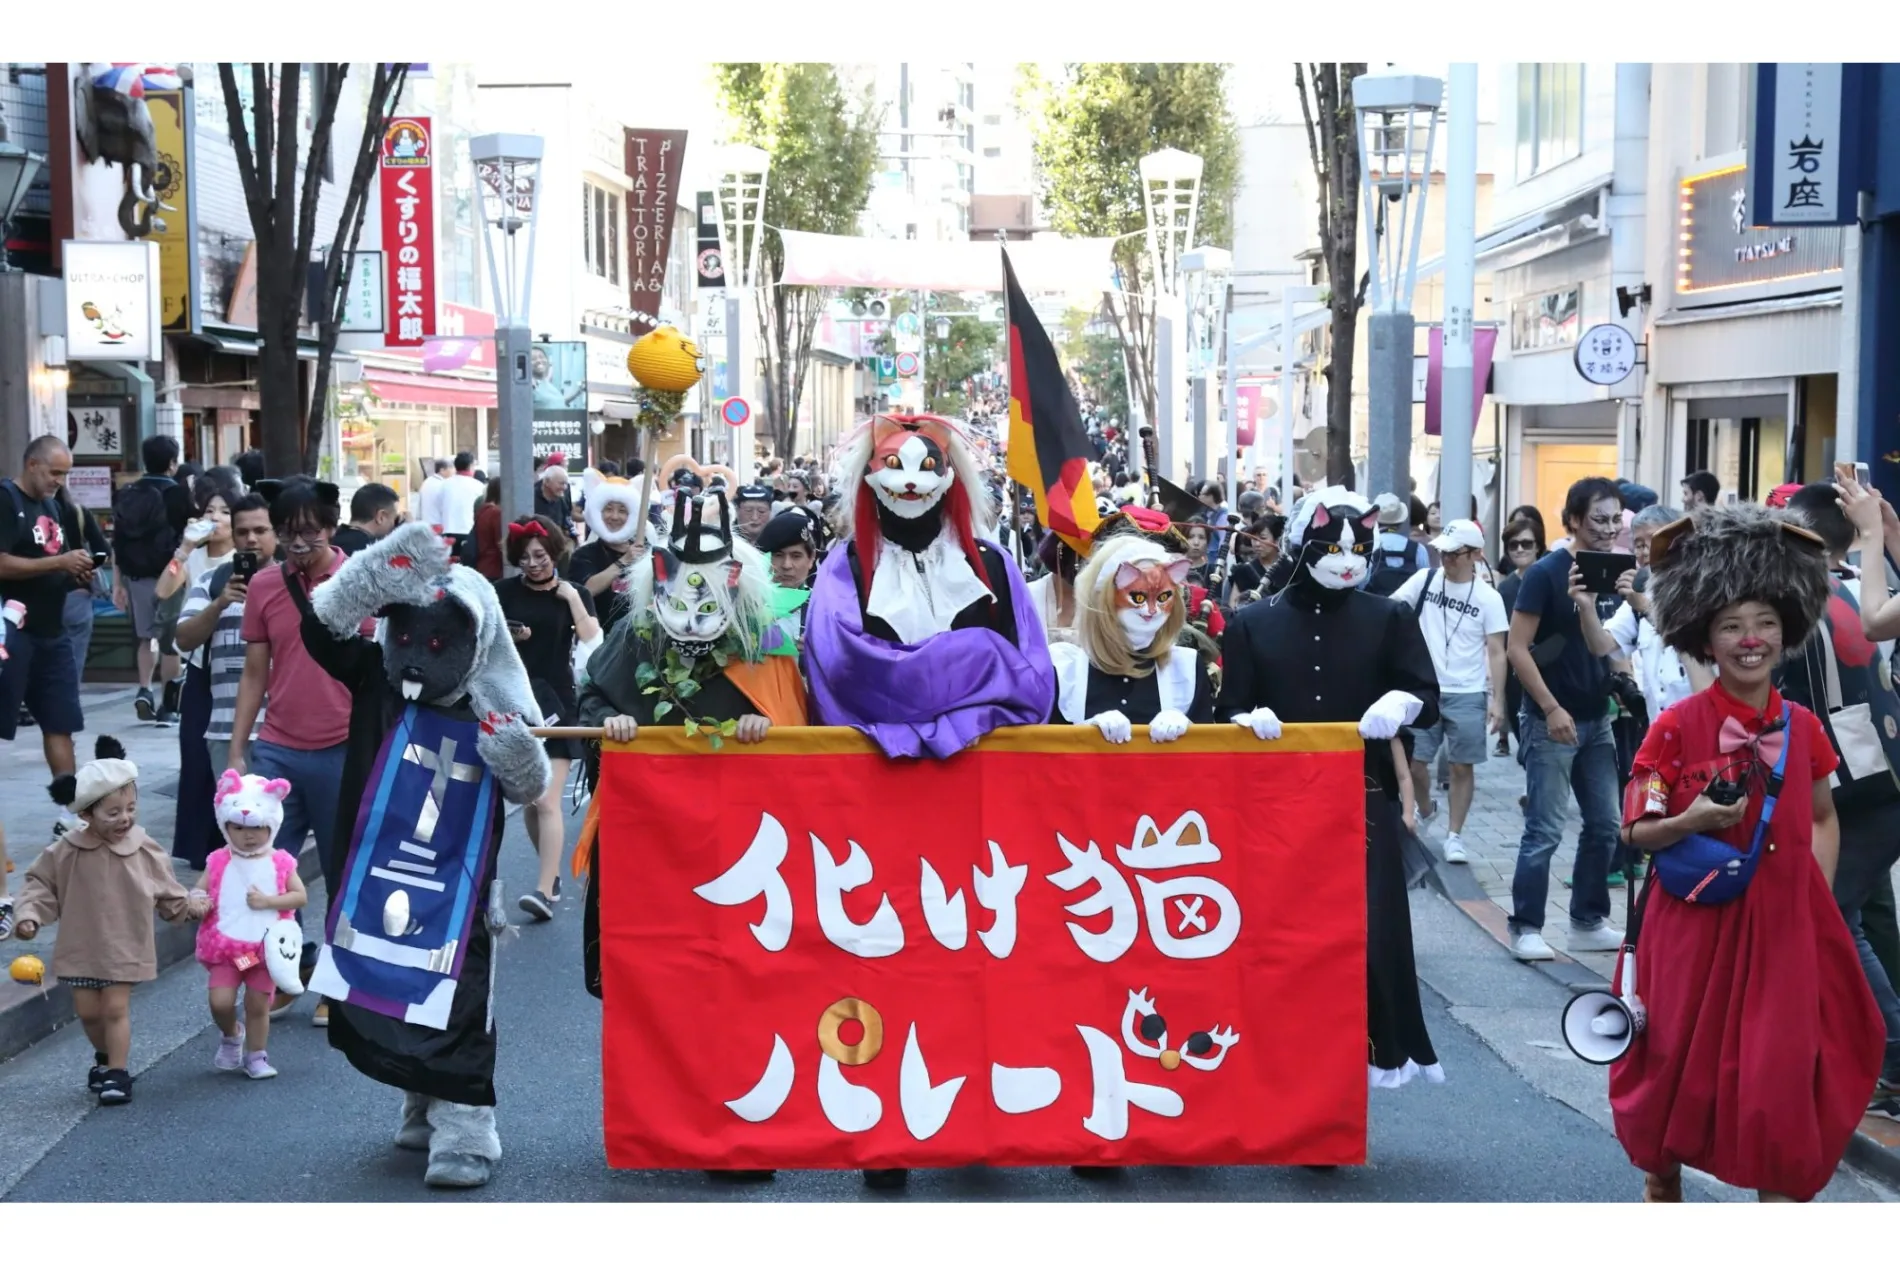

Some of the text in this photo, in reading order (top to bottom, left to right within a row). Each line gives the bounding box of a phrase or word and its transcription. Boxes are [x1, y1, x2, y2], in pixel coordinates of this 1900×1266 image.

[632, 137, 648, 292] TRATTORIA
[1783, 134, 1824, 209] 岩座
[395, 170, 423, 341] くすりの福太郎
[693, 810, 1241, 963] 化け猫
[724, 986, 1240, 1141] パレード
